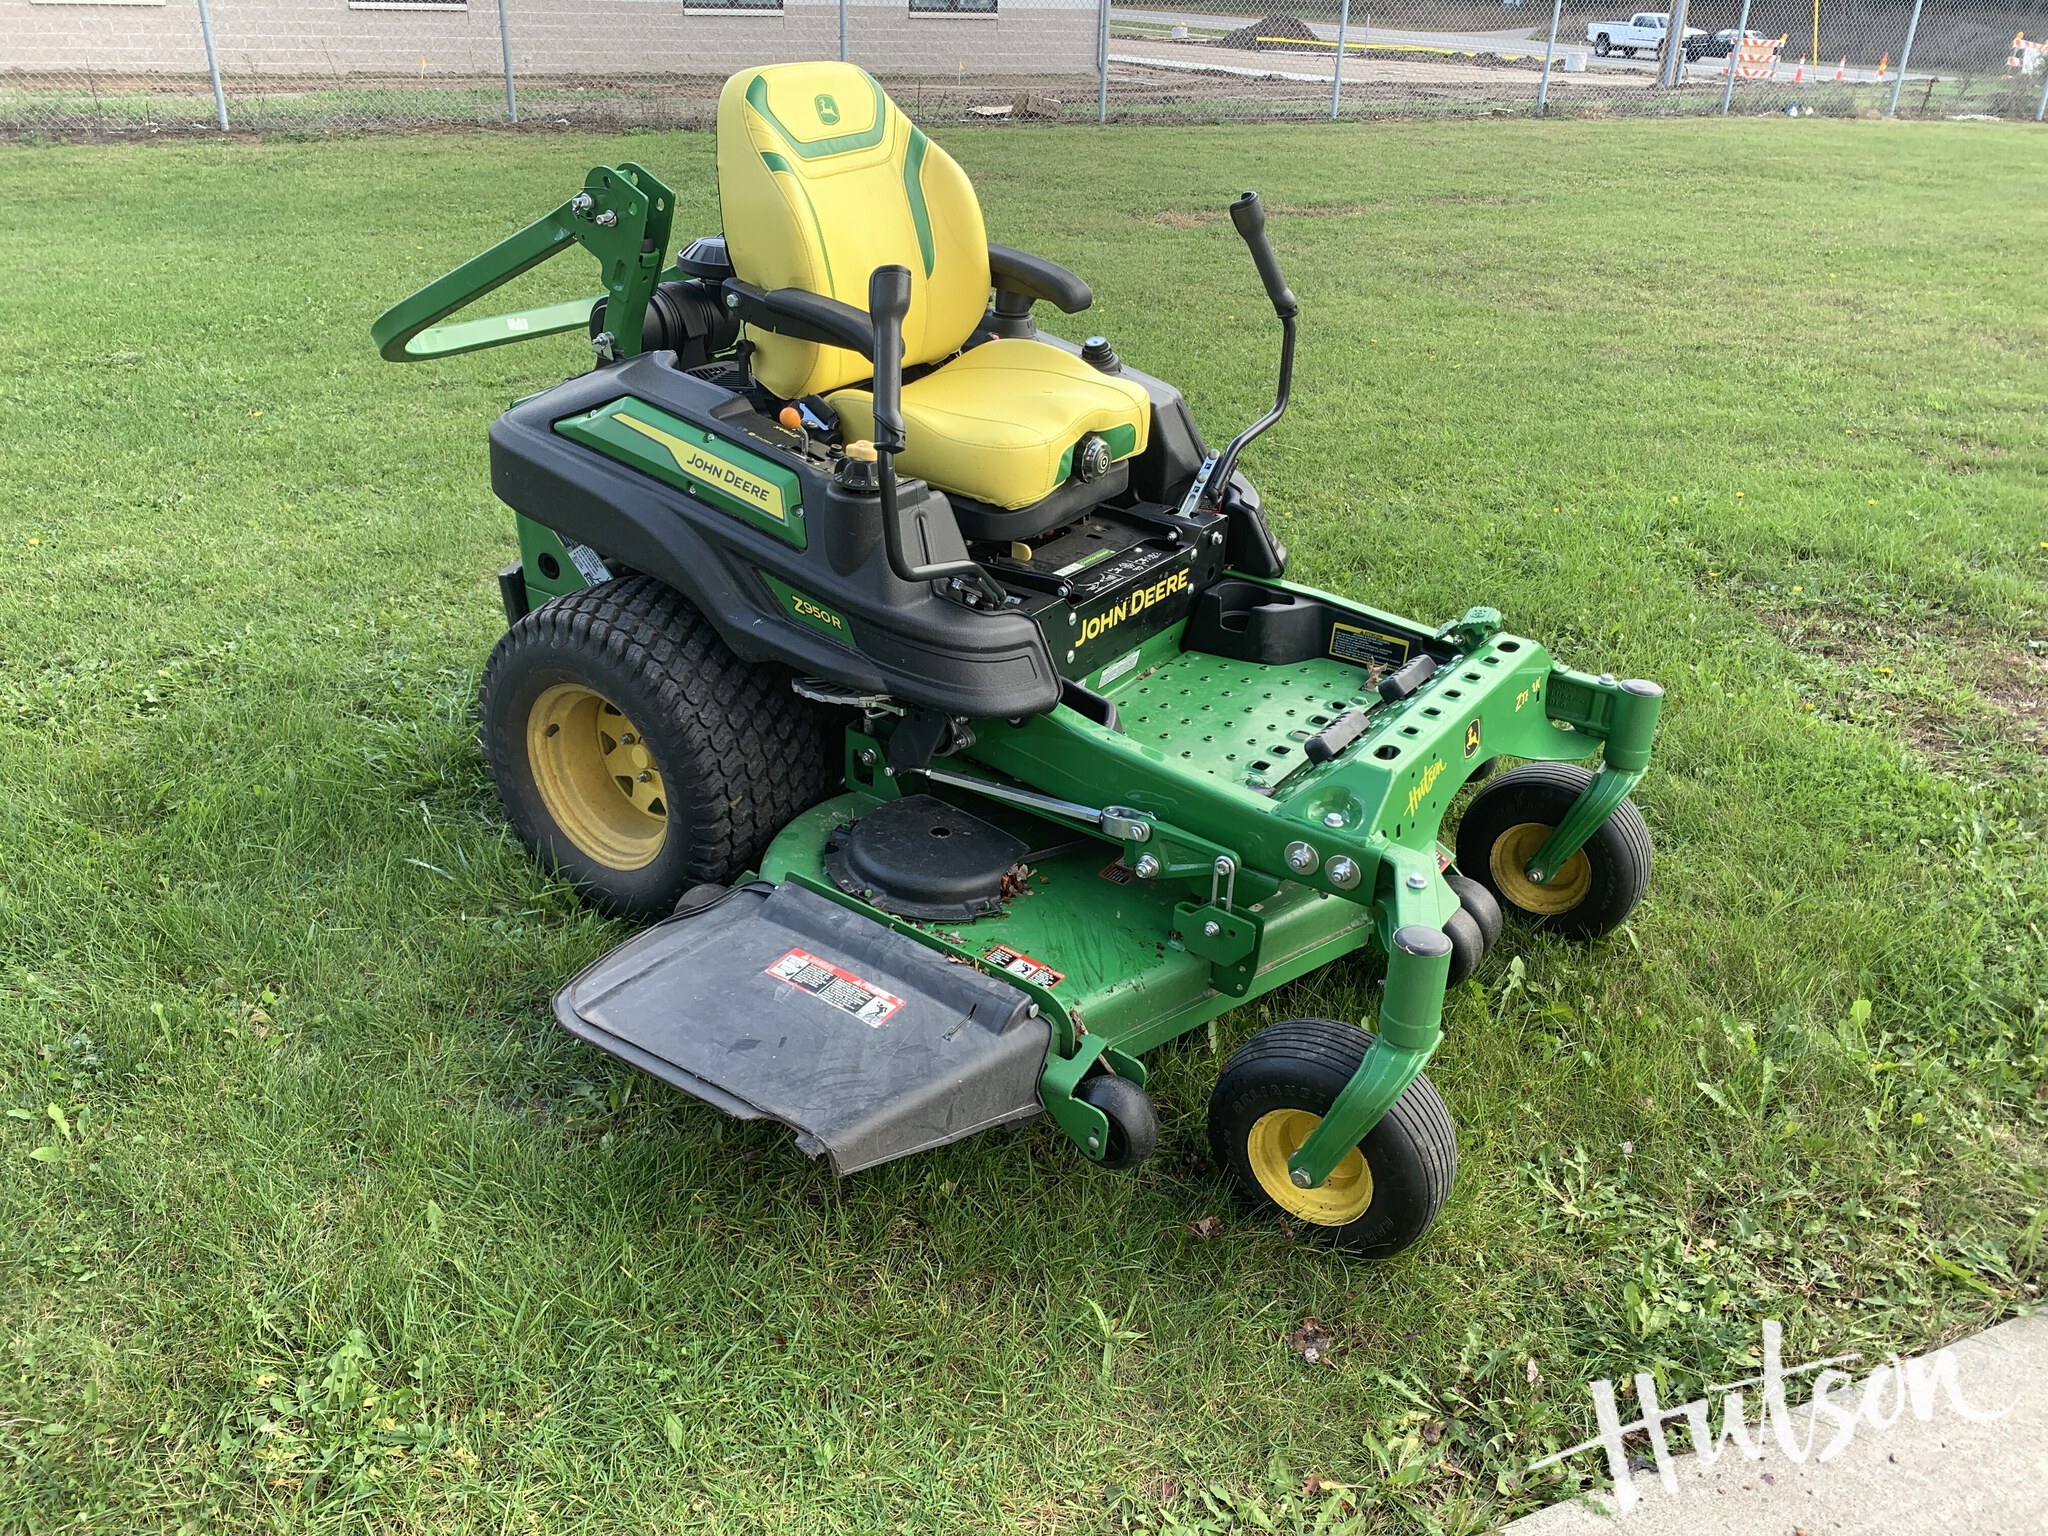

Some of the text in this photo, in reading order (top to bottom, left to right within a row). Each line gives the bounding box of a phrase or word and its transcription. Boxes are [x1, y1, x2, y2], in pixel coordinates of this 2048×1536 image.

[687, 453, 769, 502] JOHN DEERE
[792, 595, 843, 630] Z950R
[1075, 568, 1189, 647] JOHN DEERE
[1404, 758, 1447, 817] Hutson
